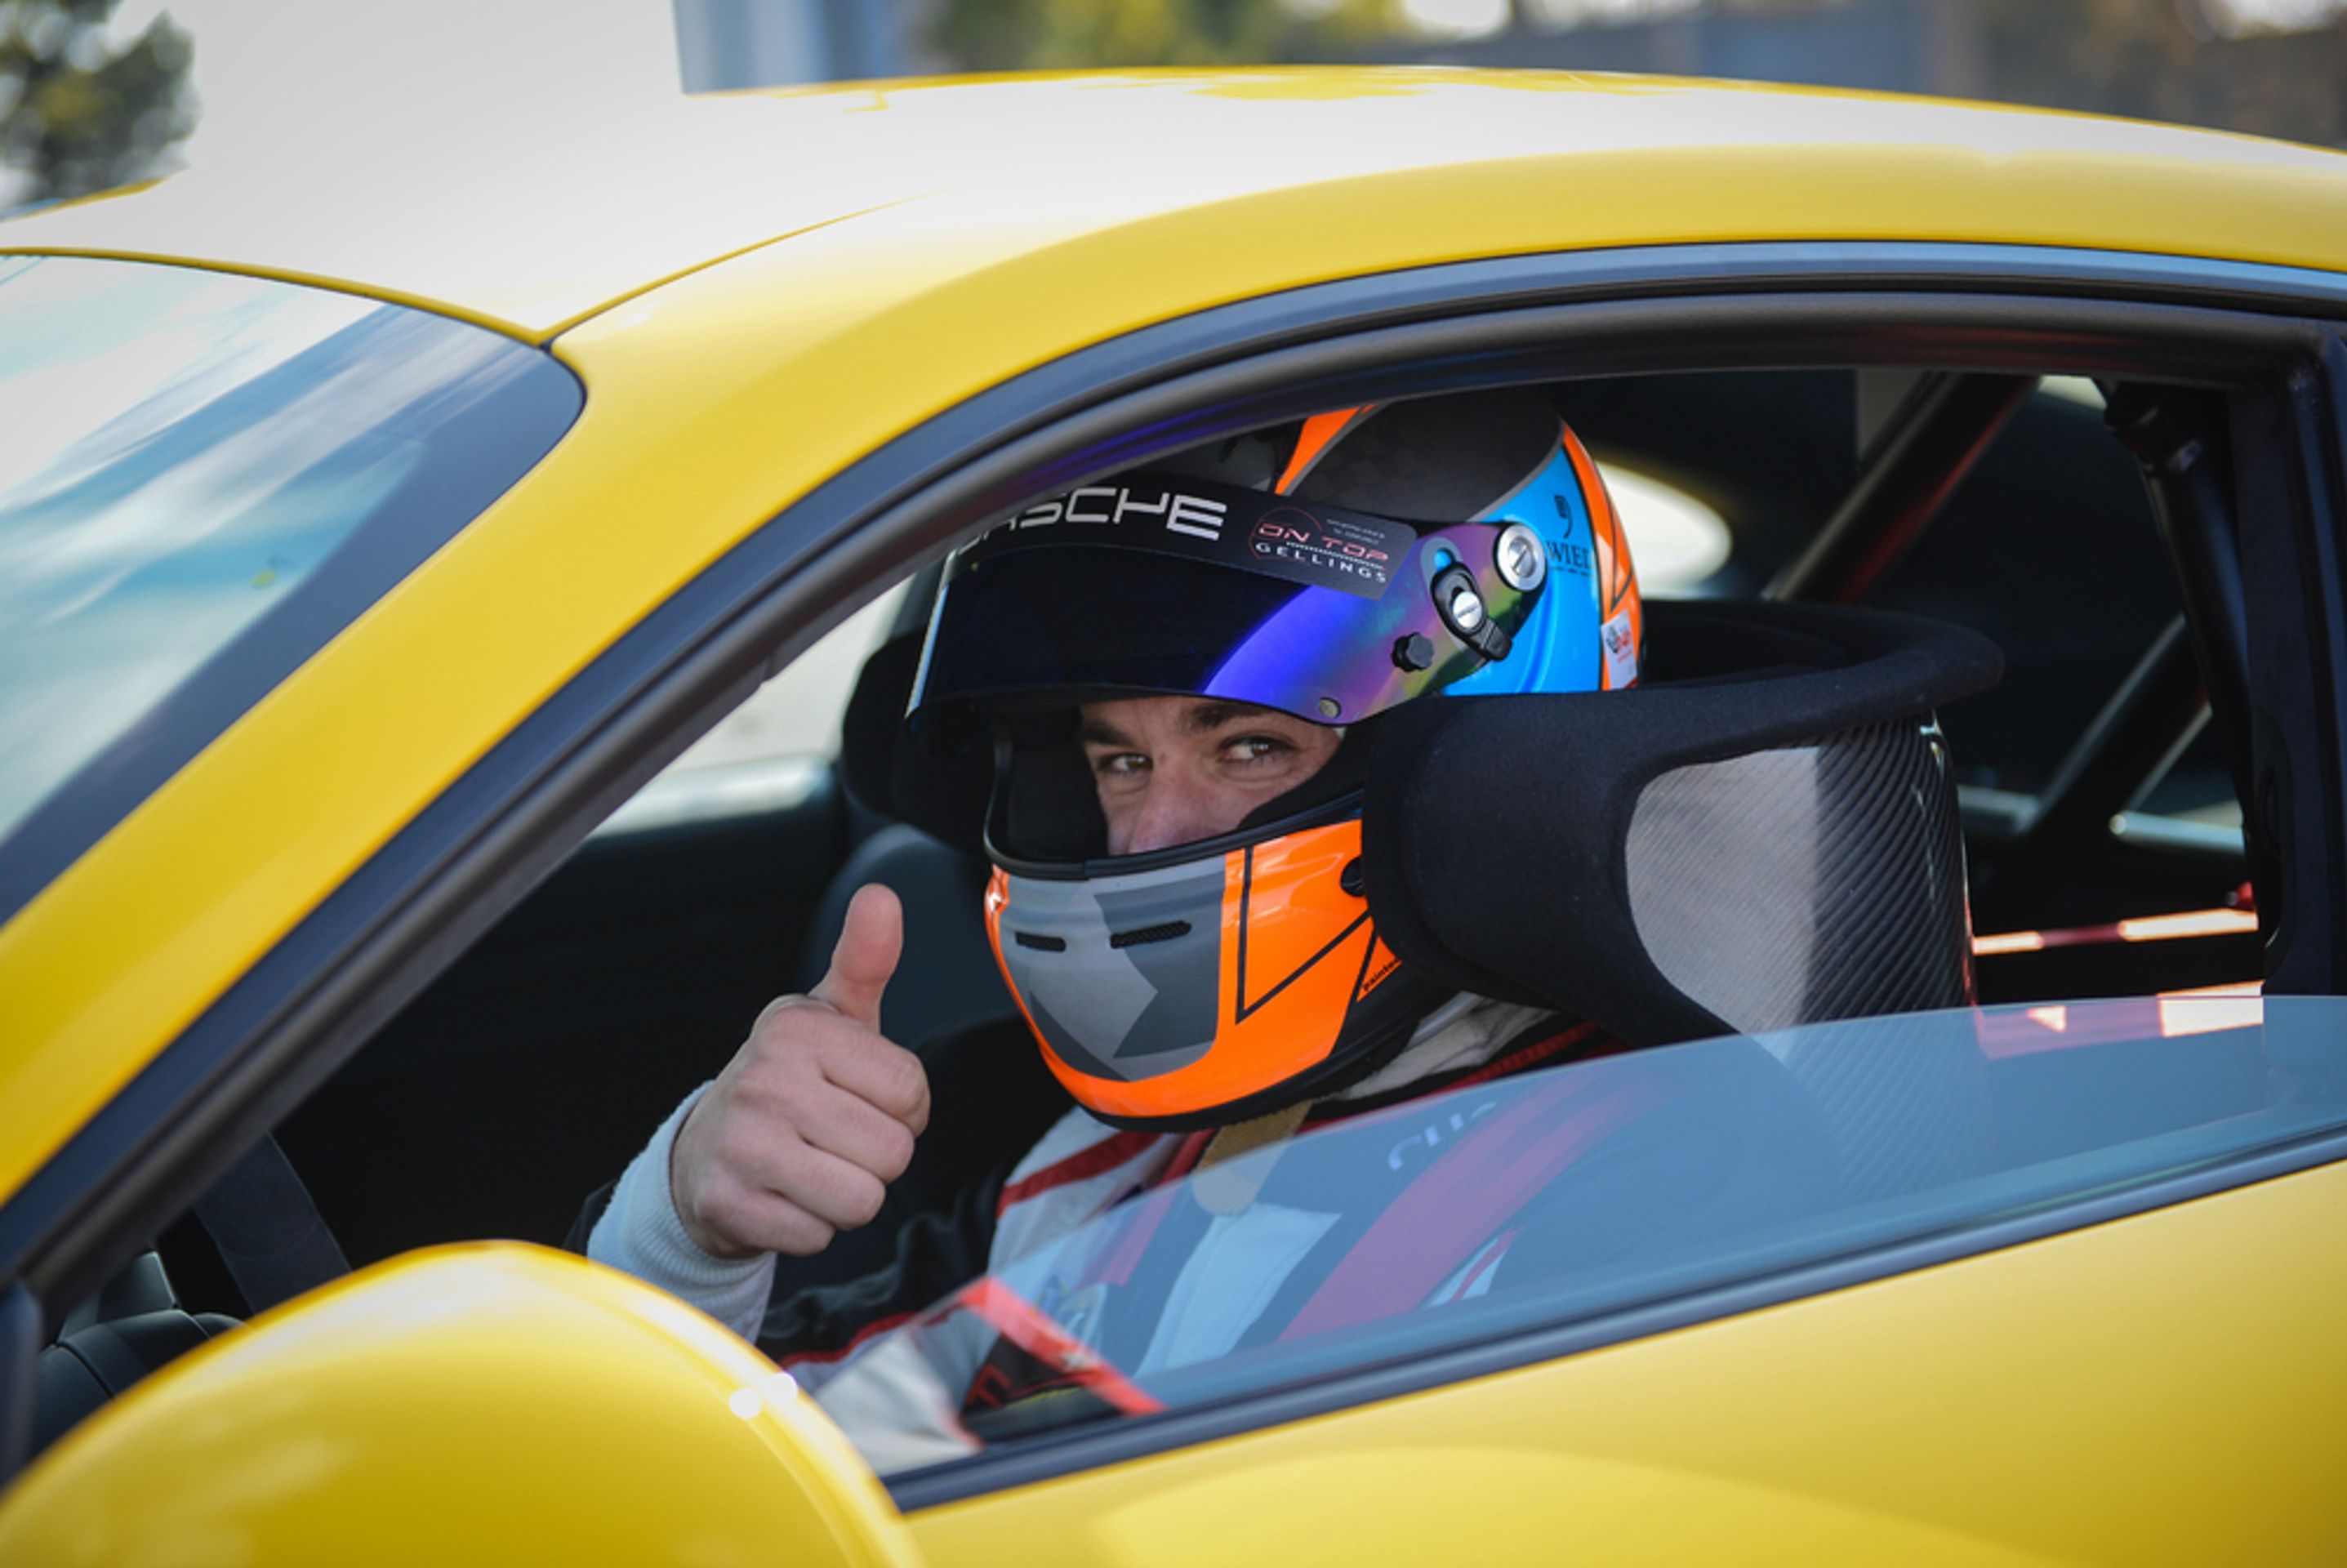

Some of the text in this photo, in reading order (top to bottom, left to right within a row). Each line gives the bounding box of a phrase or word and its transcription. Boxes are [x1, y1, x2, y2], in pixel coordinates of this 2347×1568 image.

[958, 488, 1227, 556] SCHE
[1258, 523, 1311, 543] ON
[1320, 535, 1388, 561] TOP
[1255, 541, 1387, 583] GELLINGS
